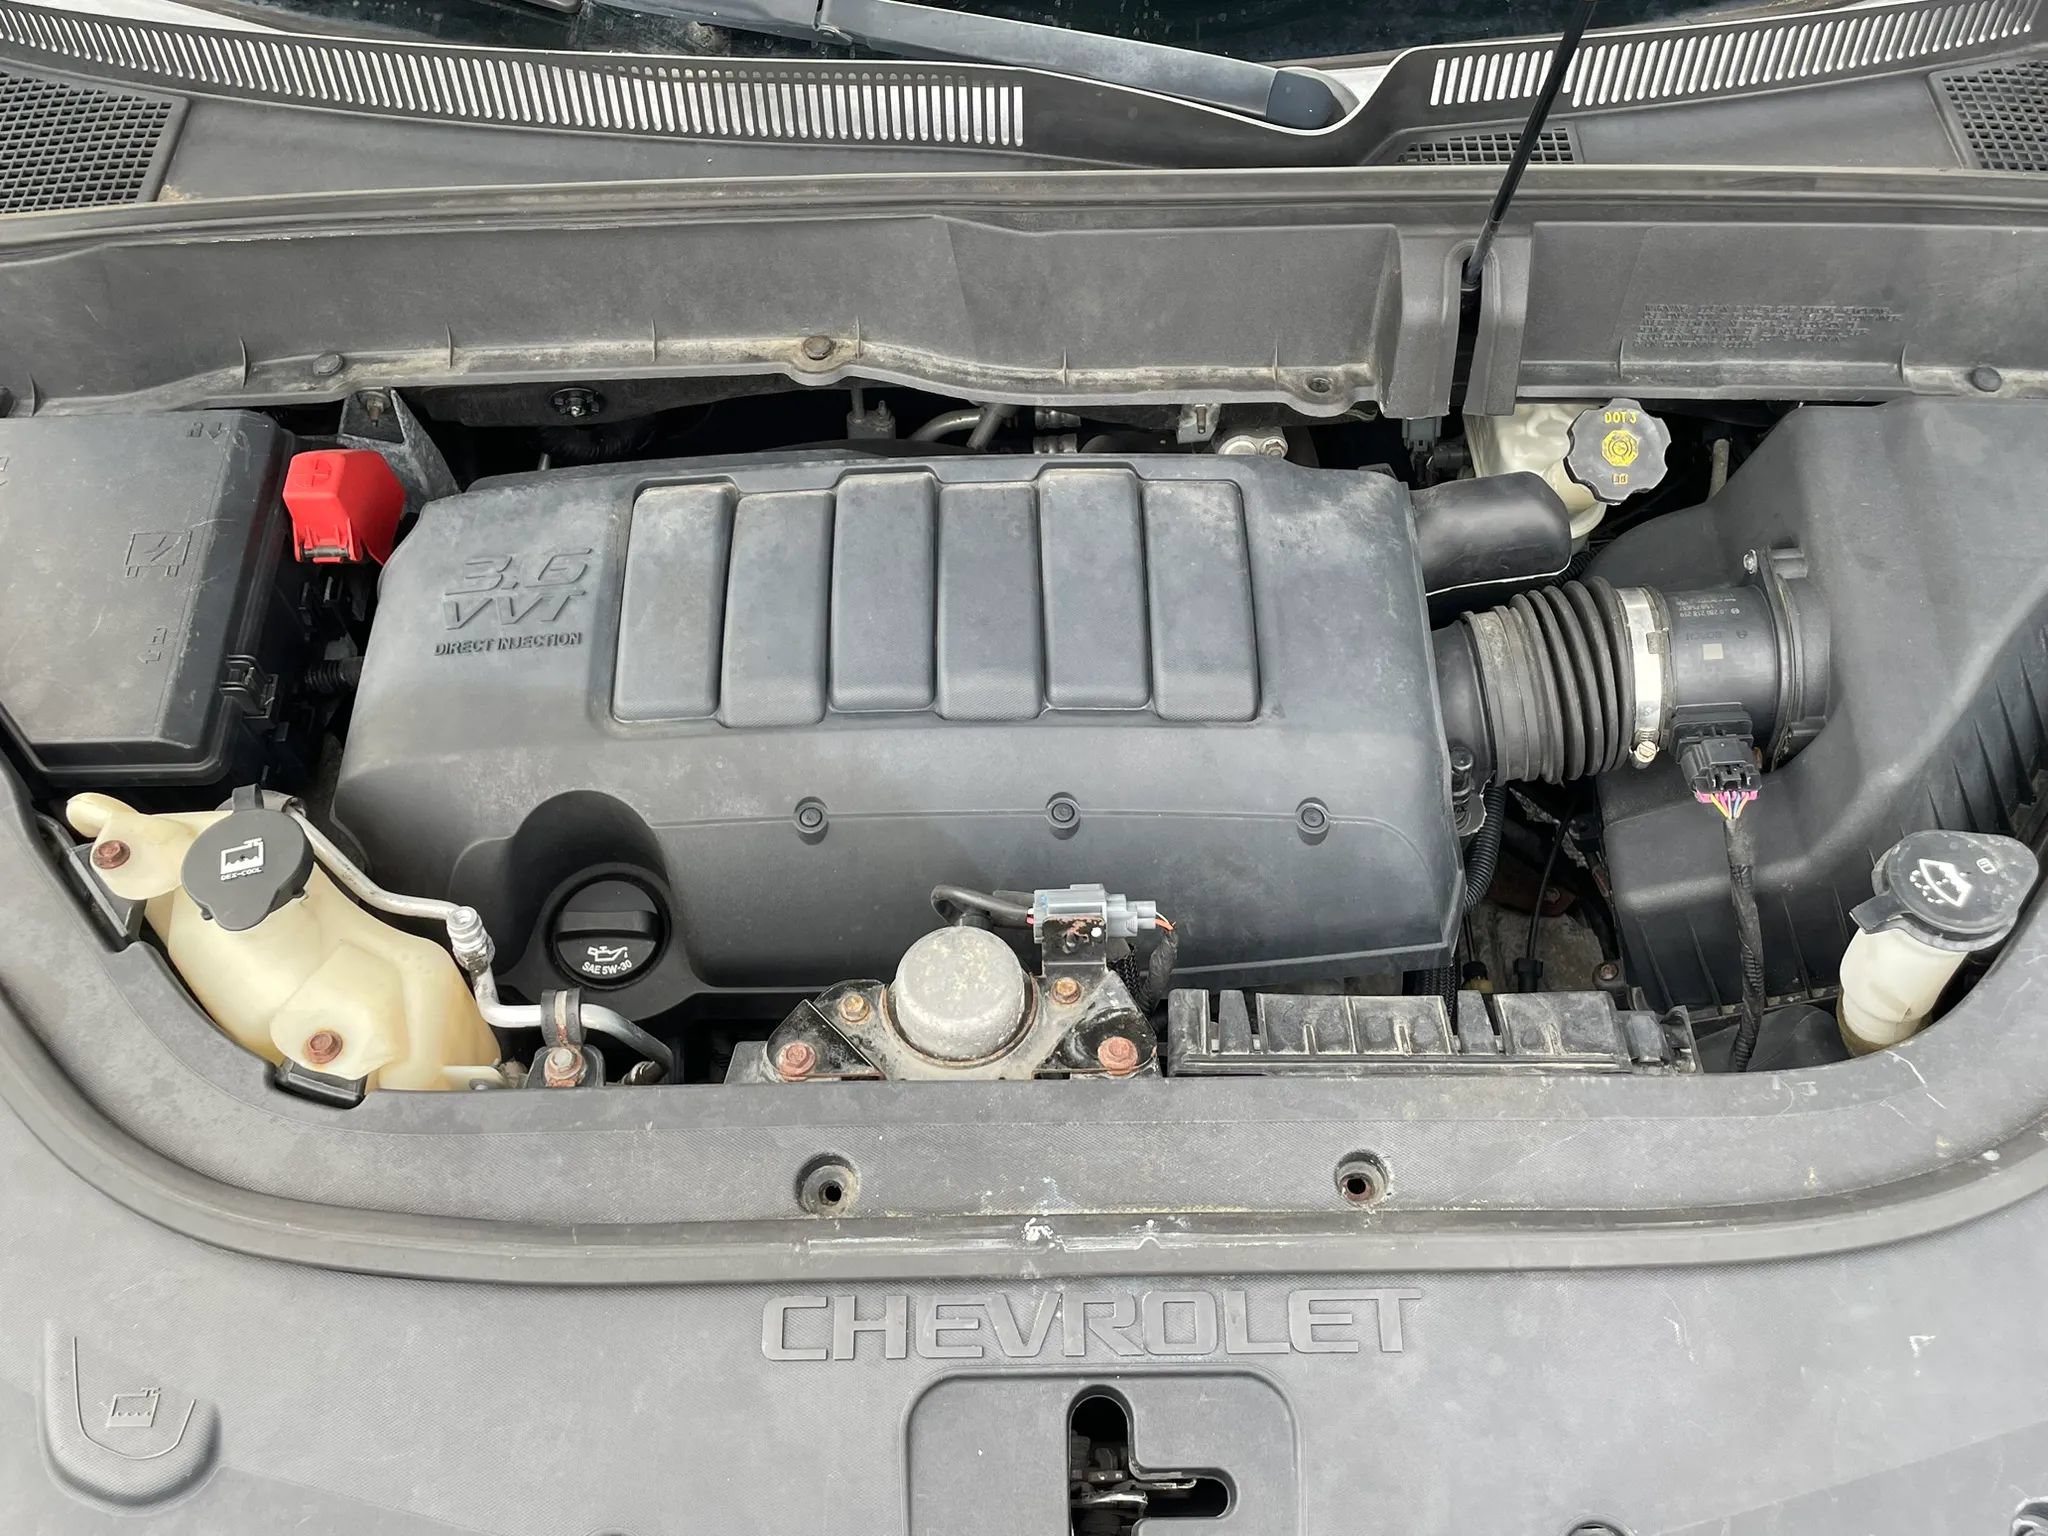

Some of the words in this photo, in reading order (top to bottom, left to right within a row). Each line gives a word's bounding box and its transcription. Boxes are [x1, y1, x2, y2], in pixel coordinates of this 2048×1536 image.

[1604, 411, 1627, 424] DOT
[1630, 411, 1637, 424] 3
[445, 548, 593, 595] 3.6
[442, 590, 587, 631] VVT
[434, 639, 496, 656] DIRECT
[497, 631, 583, 651] INJECTION
[220, 867, 262, 881] DEX-COOL
[582, 961, 601, 974] SAE
[602, 959, 632, 975] 5W-30
[762, 1288, 1422, 1361] CHEVROLET
